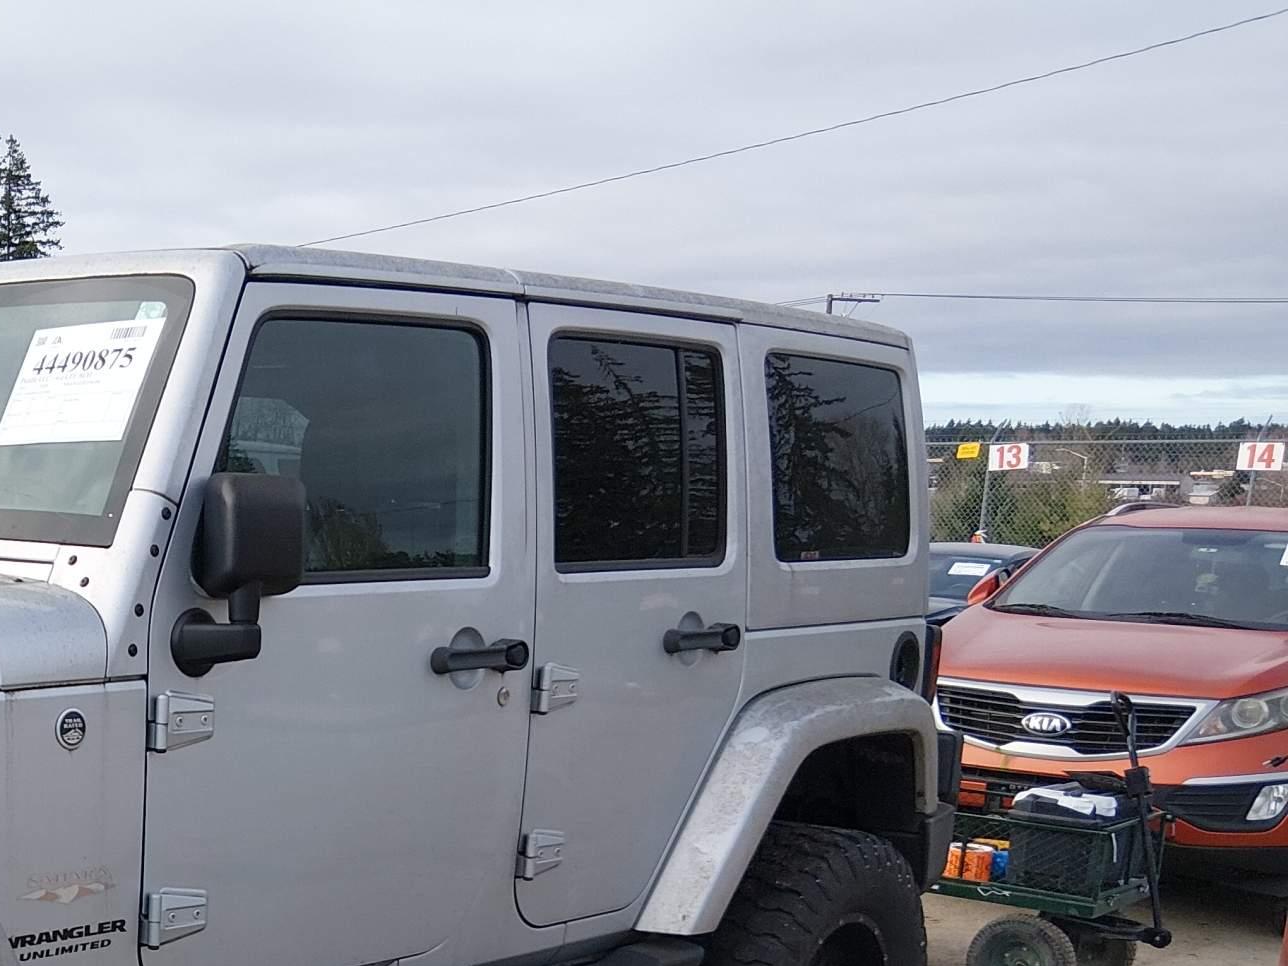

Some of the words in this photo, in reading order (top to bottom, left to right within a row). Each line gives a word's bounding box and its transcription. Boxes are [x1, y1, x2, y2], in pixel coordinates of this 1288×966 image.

[32, 347, 137, 375] 44490875
[996, 444, 1022, 469] 13
[1247, 443, 1276, 469] 14
[1028, 716, 1061, 732] KIA
[19, 939, 112, 961] UNLIMITED
